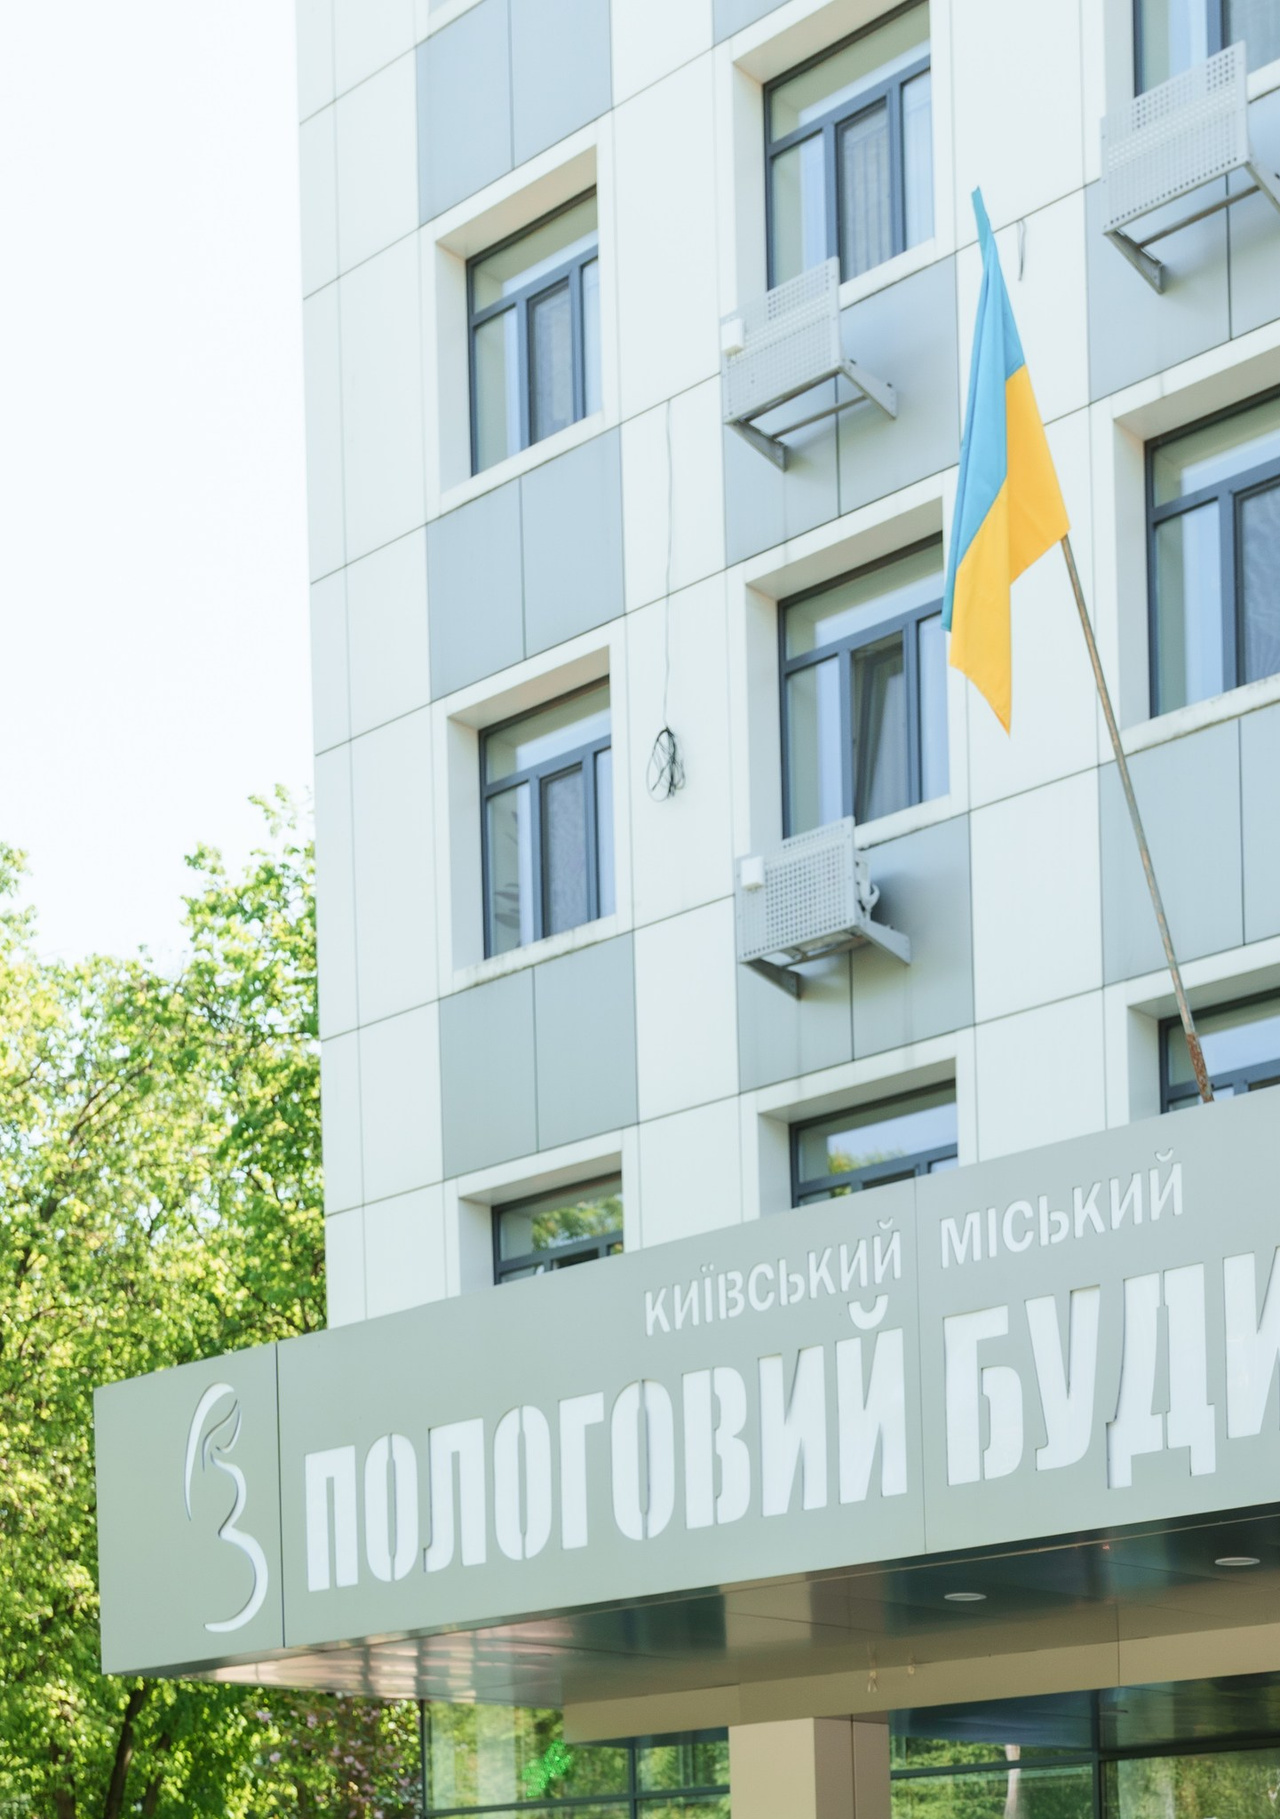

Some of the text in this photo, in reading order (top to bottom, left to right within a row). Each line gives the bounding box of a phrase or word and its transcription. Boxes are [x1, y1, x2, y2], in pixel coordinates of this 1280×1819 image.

[645, 1147, 1185, 1338] КИЇВСЬКИЙ МІСЬКИЙ
[303, 1295, 909, 1593] ПОЛОГОВИЙ
